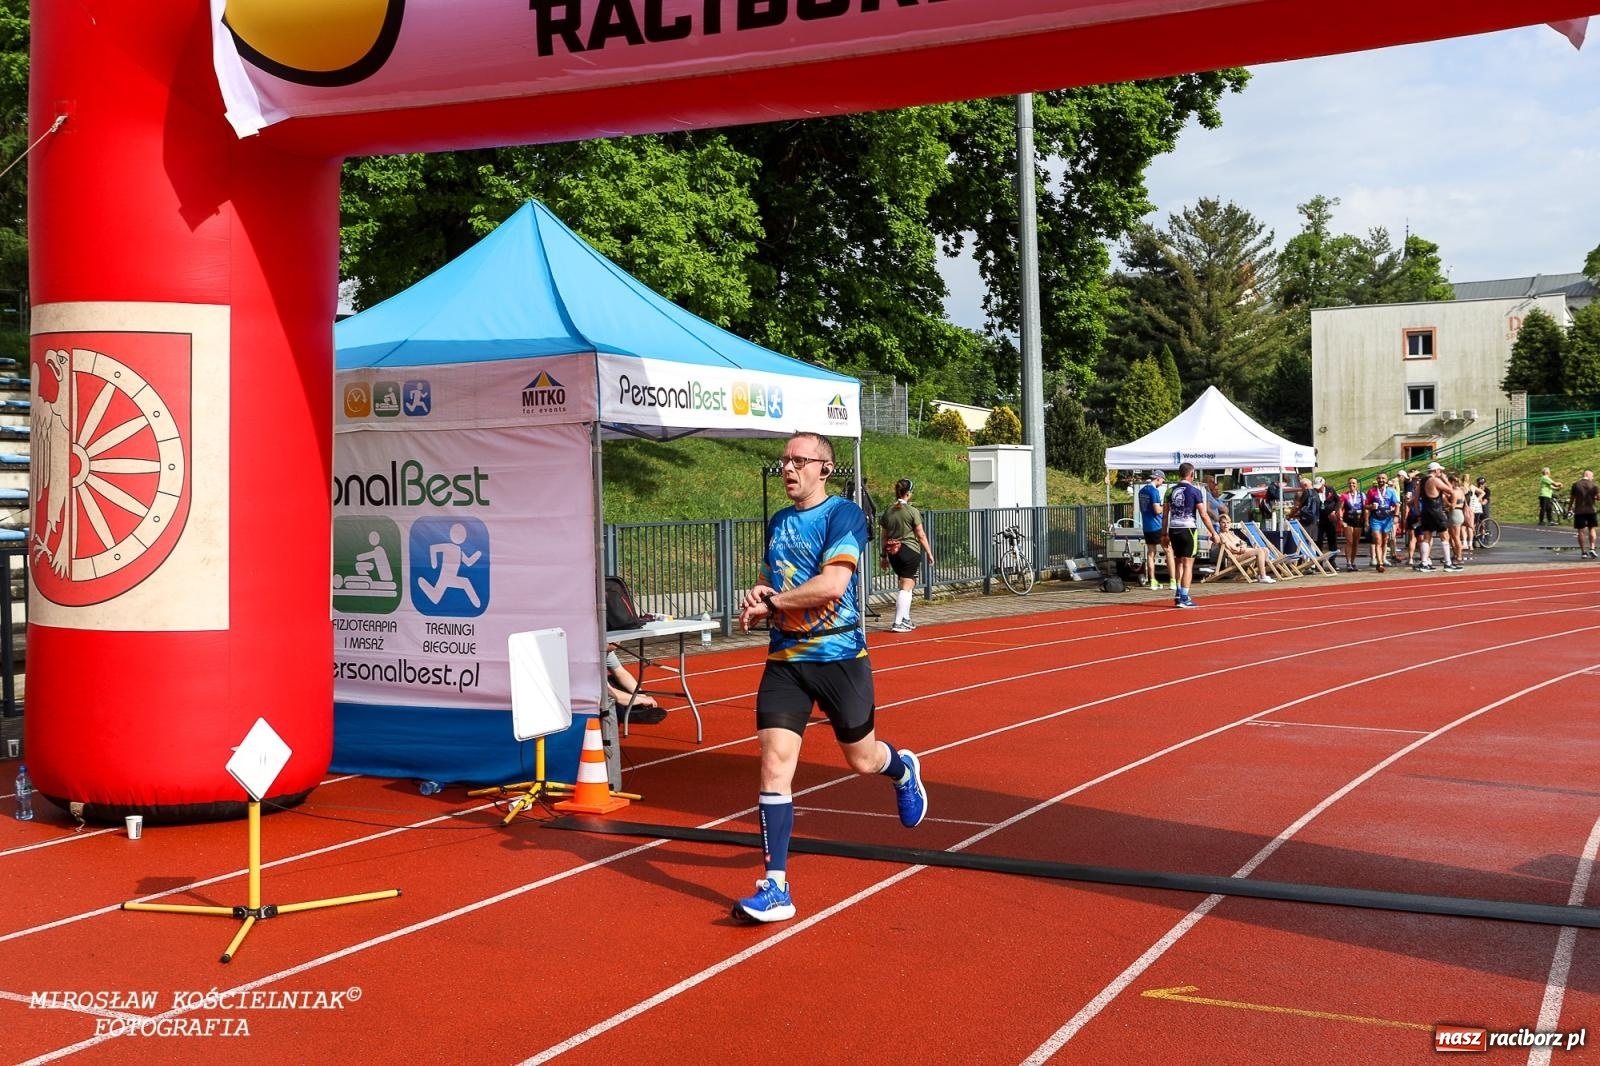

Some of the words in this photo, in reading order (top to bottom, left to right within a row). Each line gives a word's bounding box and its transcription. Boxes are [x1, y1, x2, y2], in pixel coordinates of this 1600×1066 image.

[522, 388, 566, 407] MITKO
[619, 374, 728, 411] PersonalBest
[827, 406, 848, 420] MITKO
[331, 618, 398, 633] FIZJOTERAPIA
[425, 622, 475, 637] TRENINGI
[344, 636, 348, 649] I
[349, 636, 384, 651] MASAŻ
[422, 640, 477, 655] BIEGOWE
[333, 658, 480, 693] ersonalbest.pl
